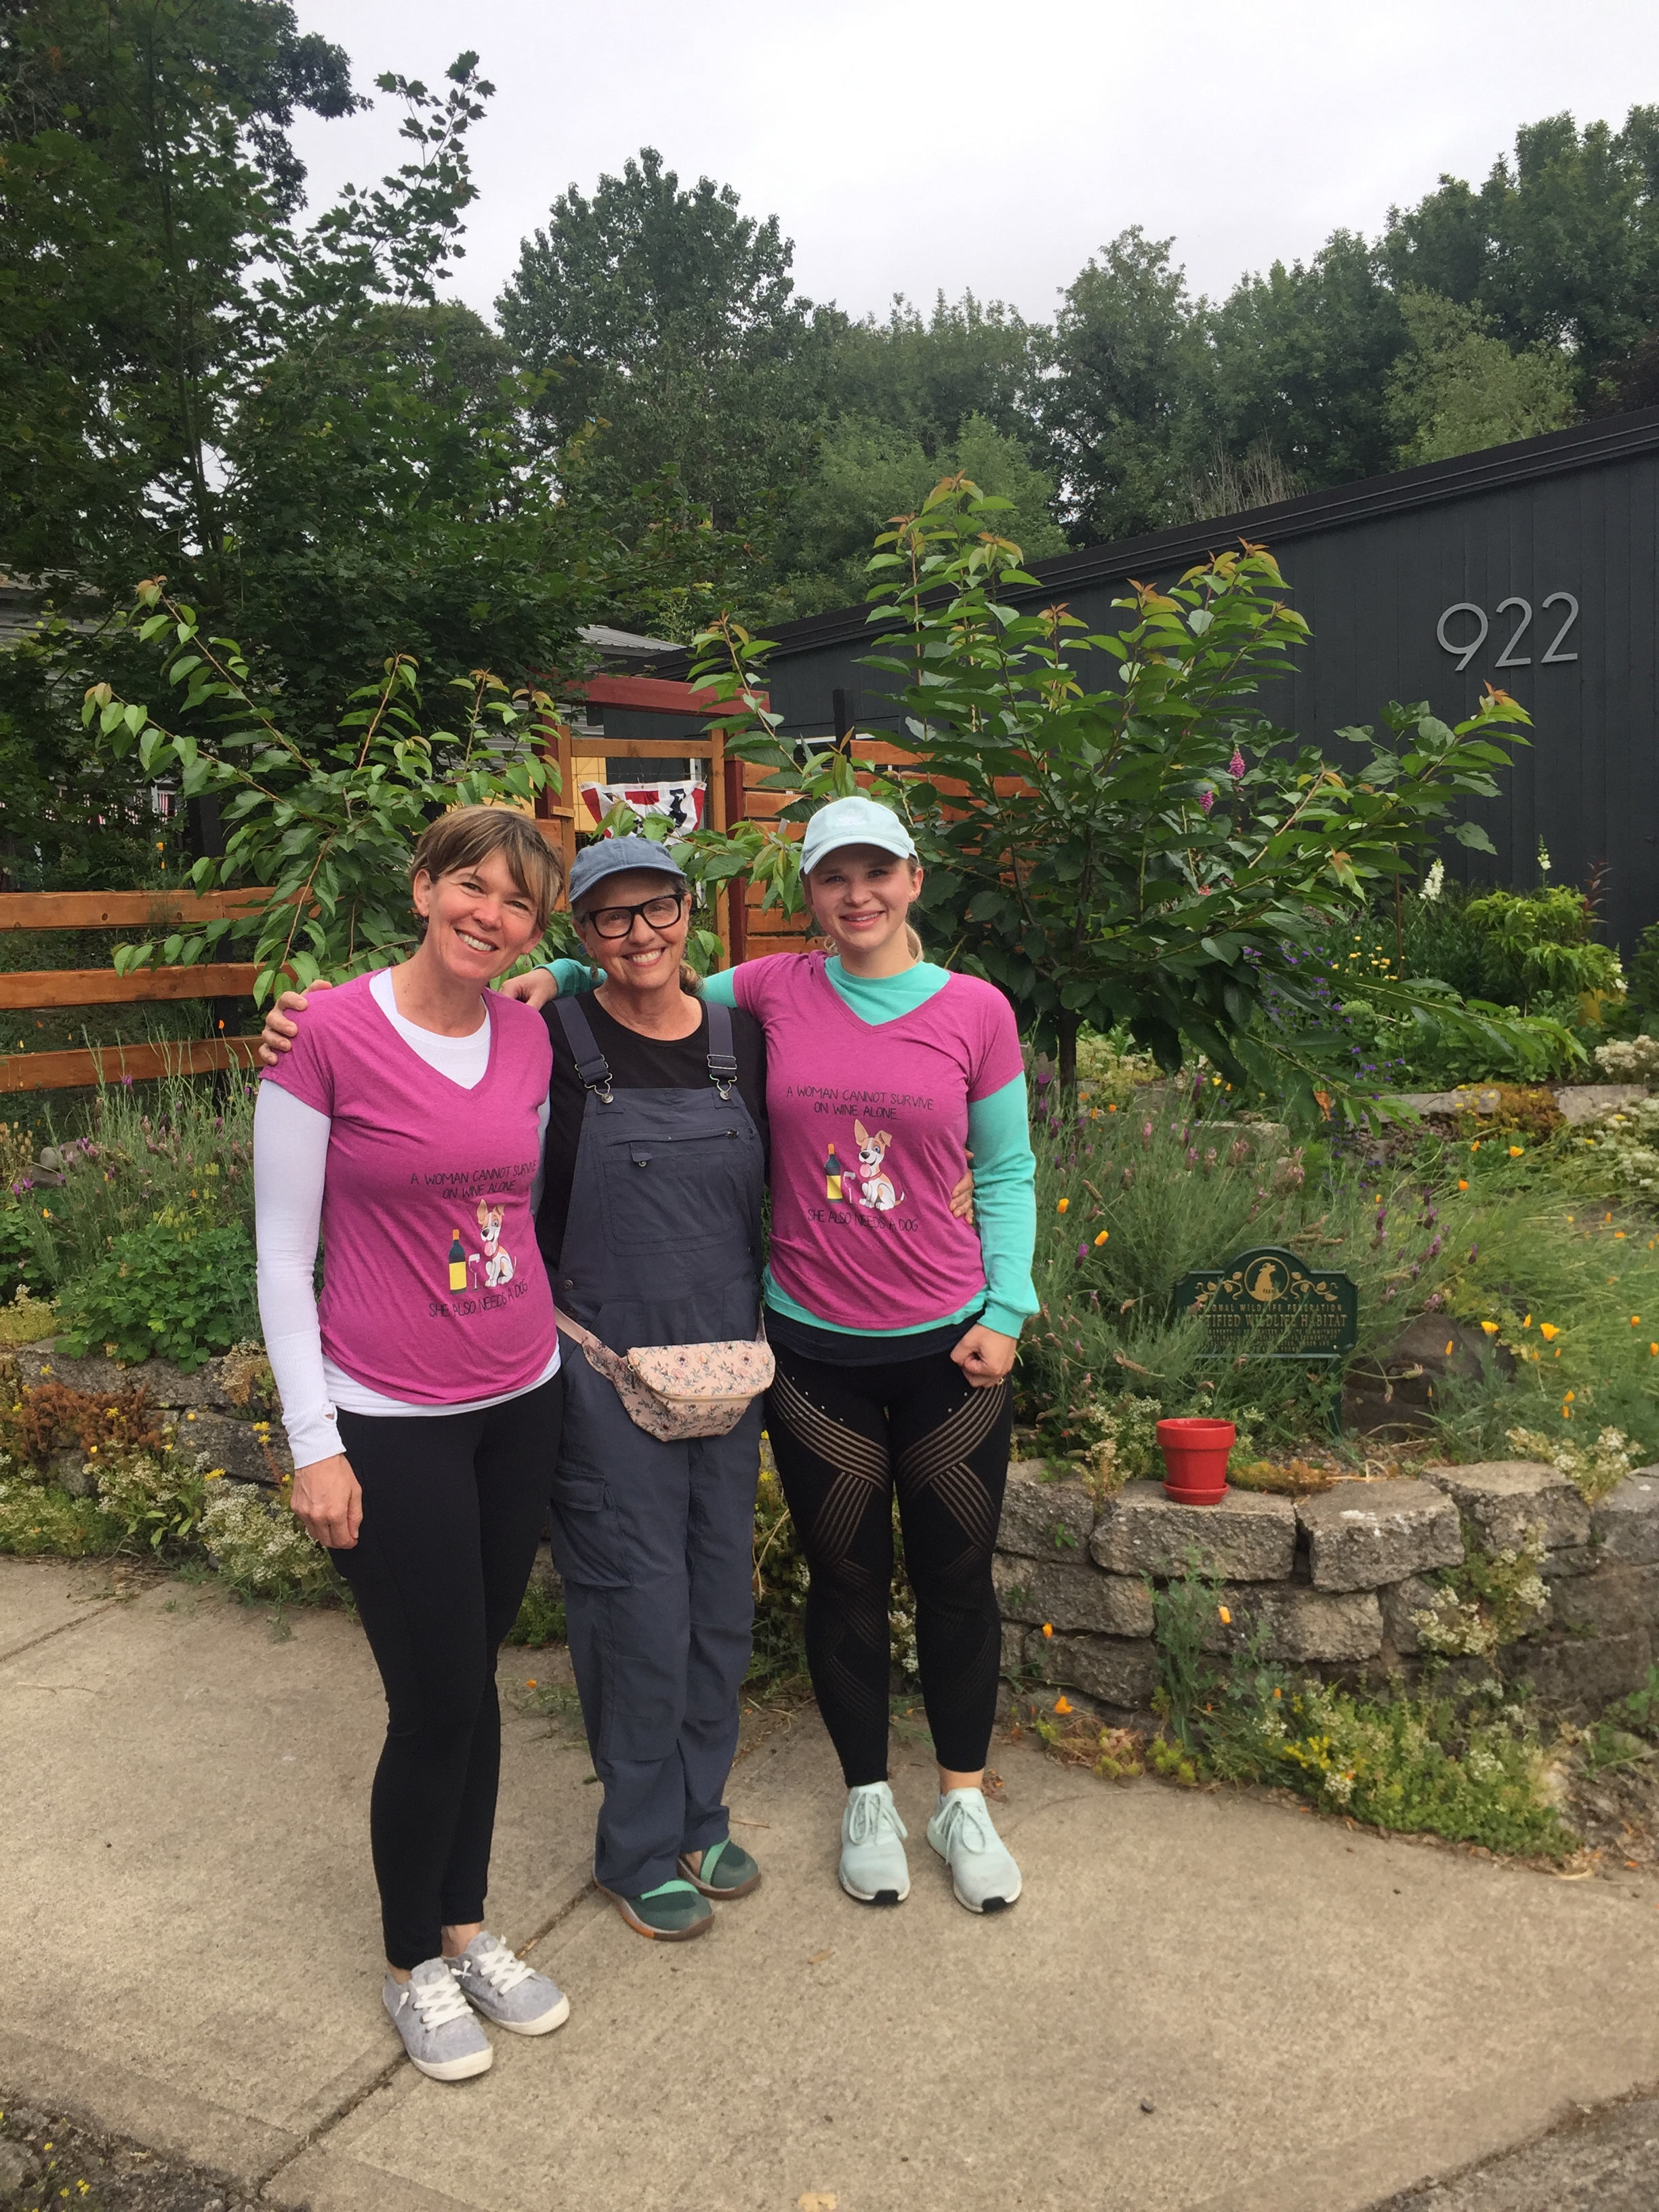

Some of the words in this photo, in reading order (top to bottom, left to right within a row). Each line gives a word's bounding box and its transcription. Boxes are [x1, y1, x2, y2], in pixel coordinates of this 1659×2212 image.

[1436, 591, 1579, 671] 922
[786, 1086, 793, 1097] A
[797, 1086, 838, 1099] WOMAN
[842, 1089, 886, 1103] CANNOT
[890, 1092, 934, 1111] SURVIVE
[814, 1101, 828, 1113] ON
[834, 1104, 858, 1116] WINE
[863, 1105, 897, 1119] ALONE
[411, 1172, 419, 1185] A
[424, 1171, 469, 1185] WOMAN
[472, 1166, 512, 1183] CANNOT
[442, 1187, 458, 1200] ON
[462, 1184, 485, 1198] WINE
[487, 1180, 516, 1195] ALONE
[807, 1208, 825, 1223] SHE
[828, 1210, 852, 1225] ALSO
[855, 1213, 884, 1229] NEEDS
[888, 1218, 897, 1231] A
[899, 1218, 918, 1232] DOG
[429, 1302, 450, 1317] SHE
[452, 1300, 476, 1318] ALSO
[478, 1291, 508, 1313] NEEDS
[508, 1288, 514, 1303] A
[514, 1279, 529, 1299] DOG
[1193, 1304, 1234, 1312] TONAL
[1239, 1304, 1282, 1312] WILDIFE
[1287, 1304, 1343, 1312] FEERATION
